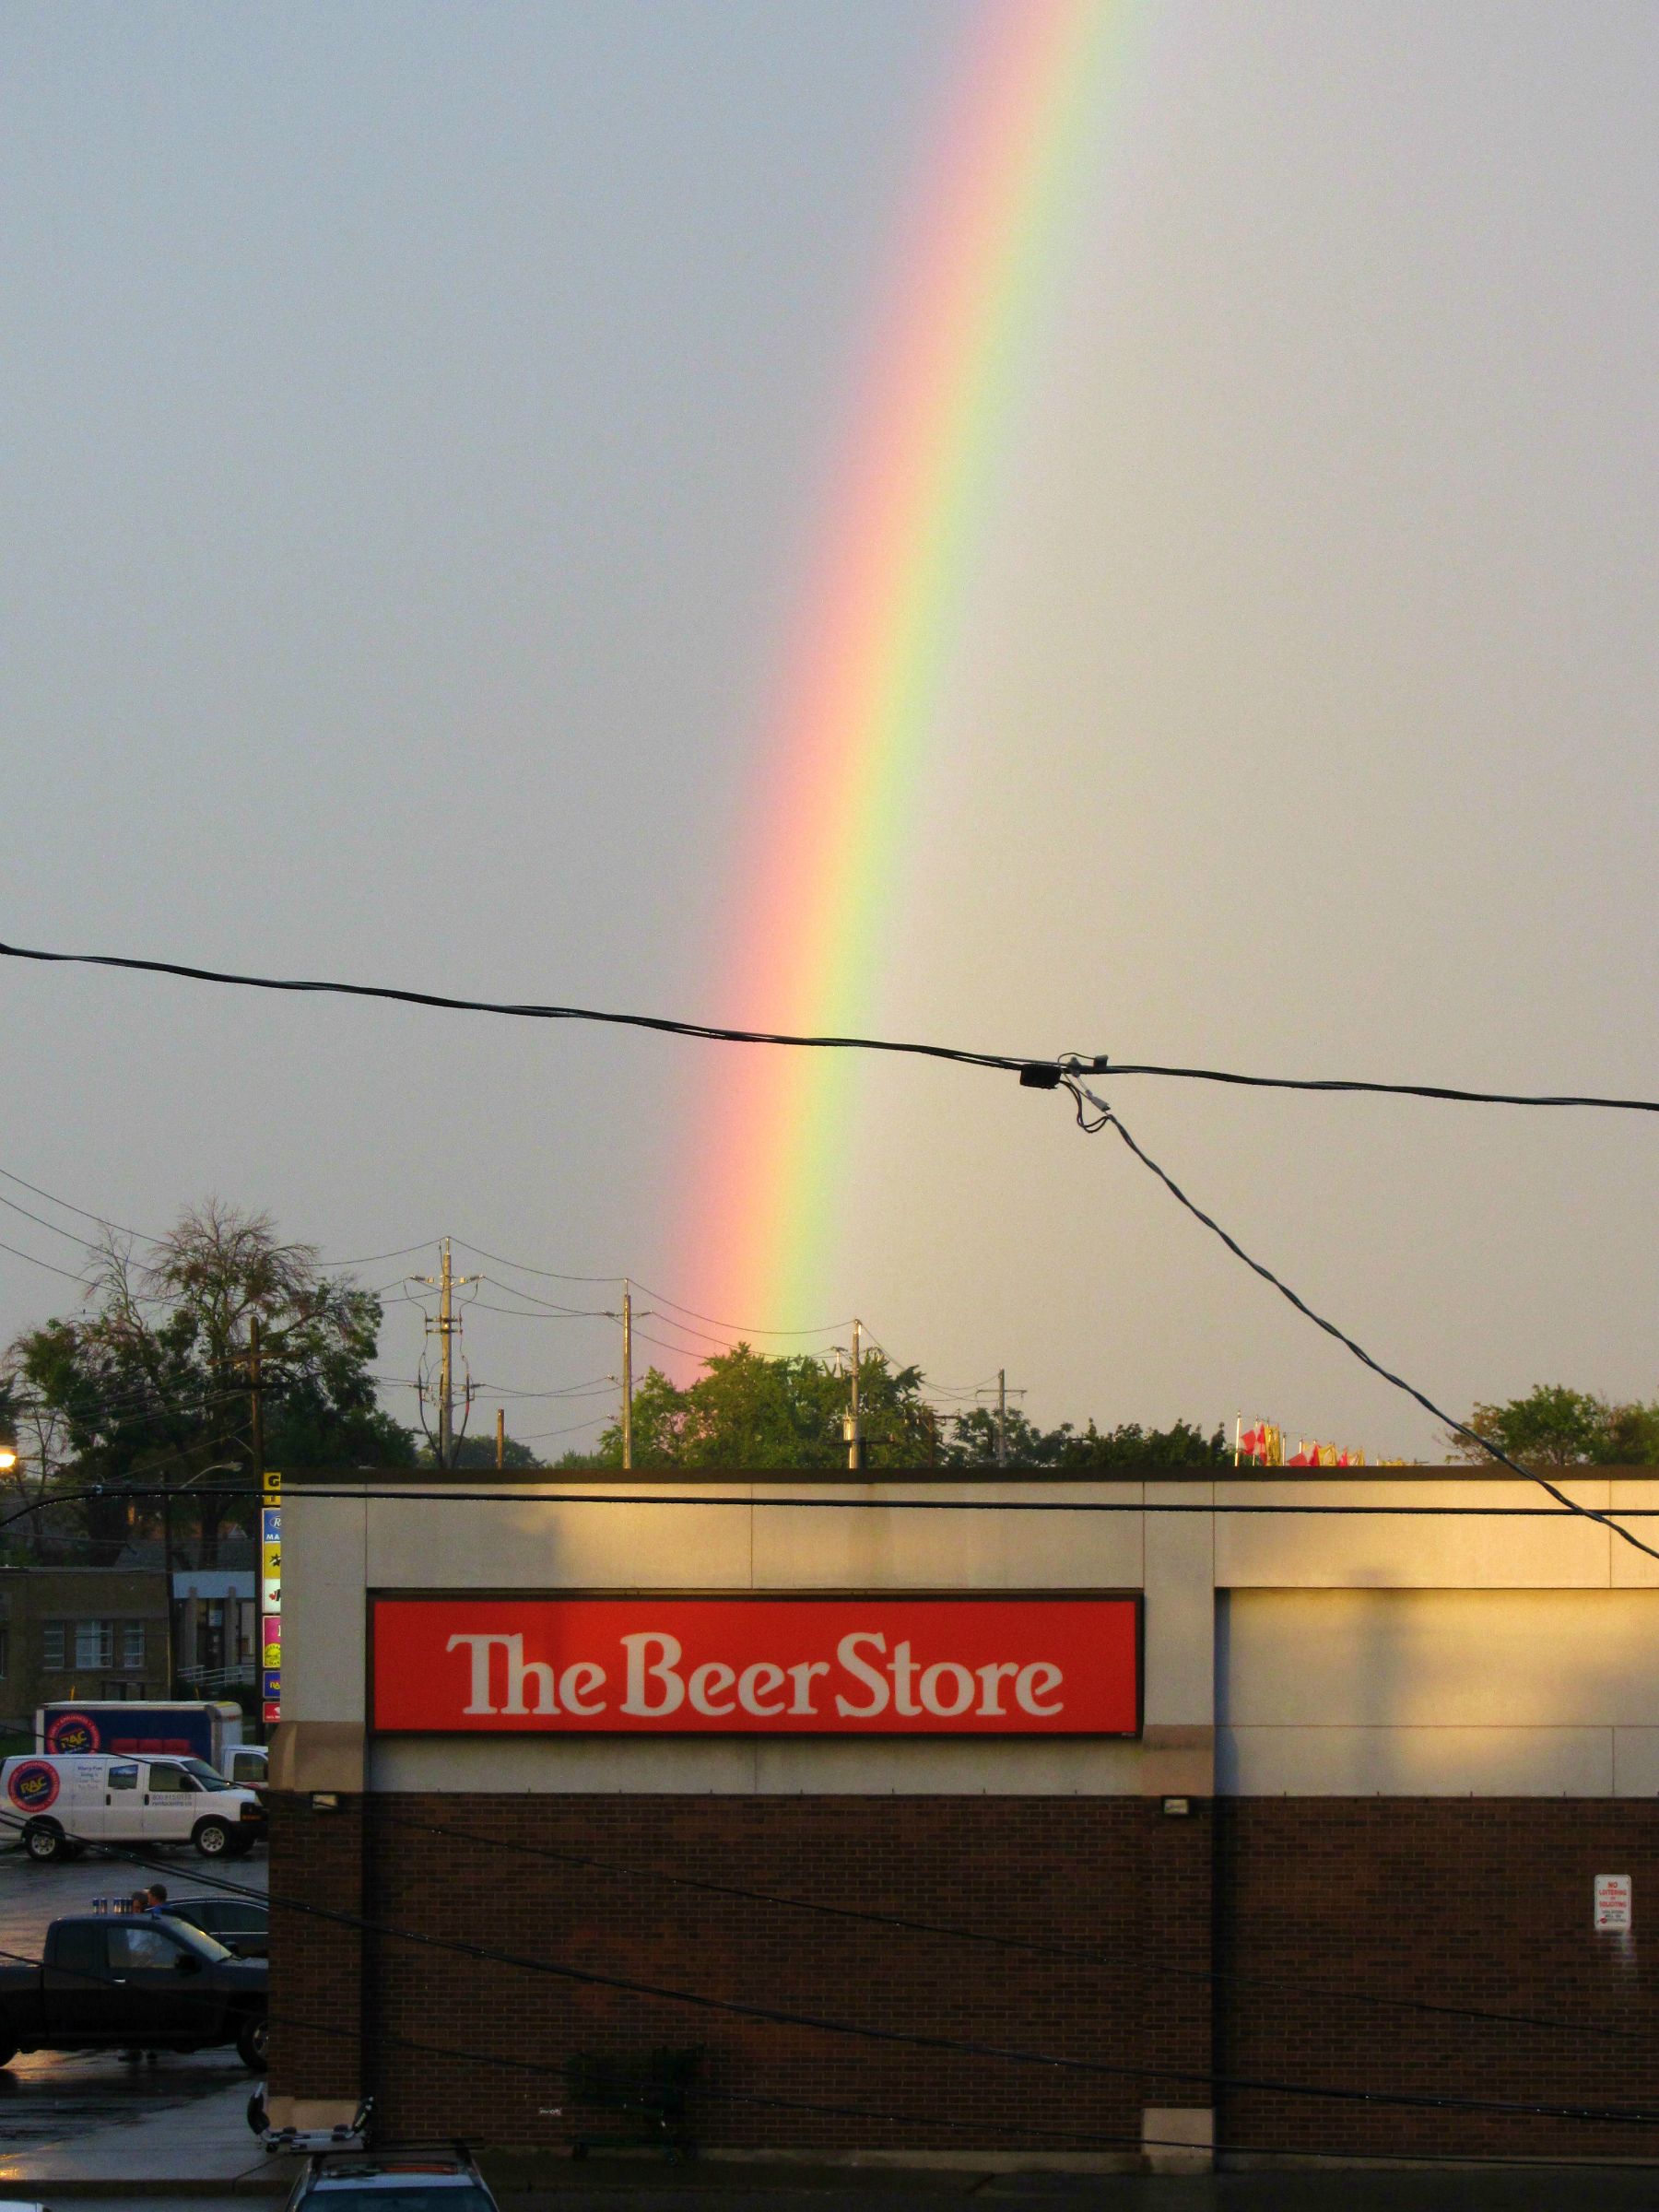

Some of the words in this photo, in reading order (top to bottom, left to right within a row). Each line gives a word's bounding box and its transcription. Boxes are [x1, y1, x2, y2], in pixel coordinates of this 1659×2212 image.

[447, 1633, 606, 1716] The
[620, 1632, 830, 1716] Beer
[836, 1632, 1064, 1717] Store
[60, 1730, 88, 1748] RAC
[20, 1776, 47, 1794] RAC
